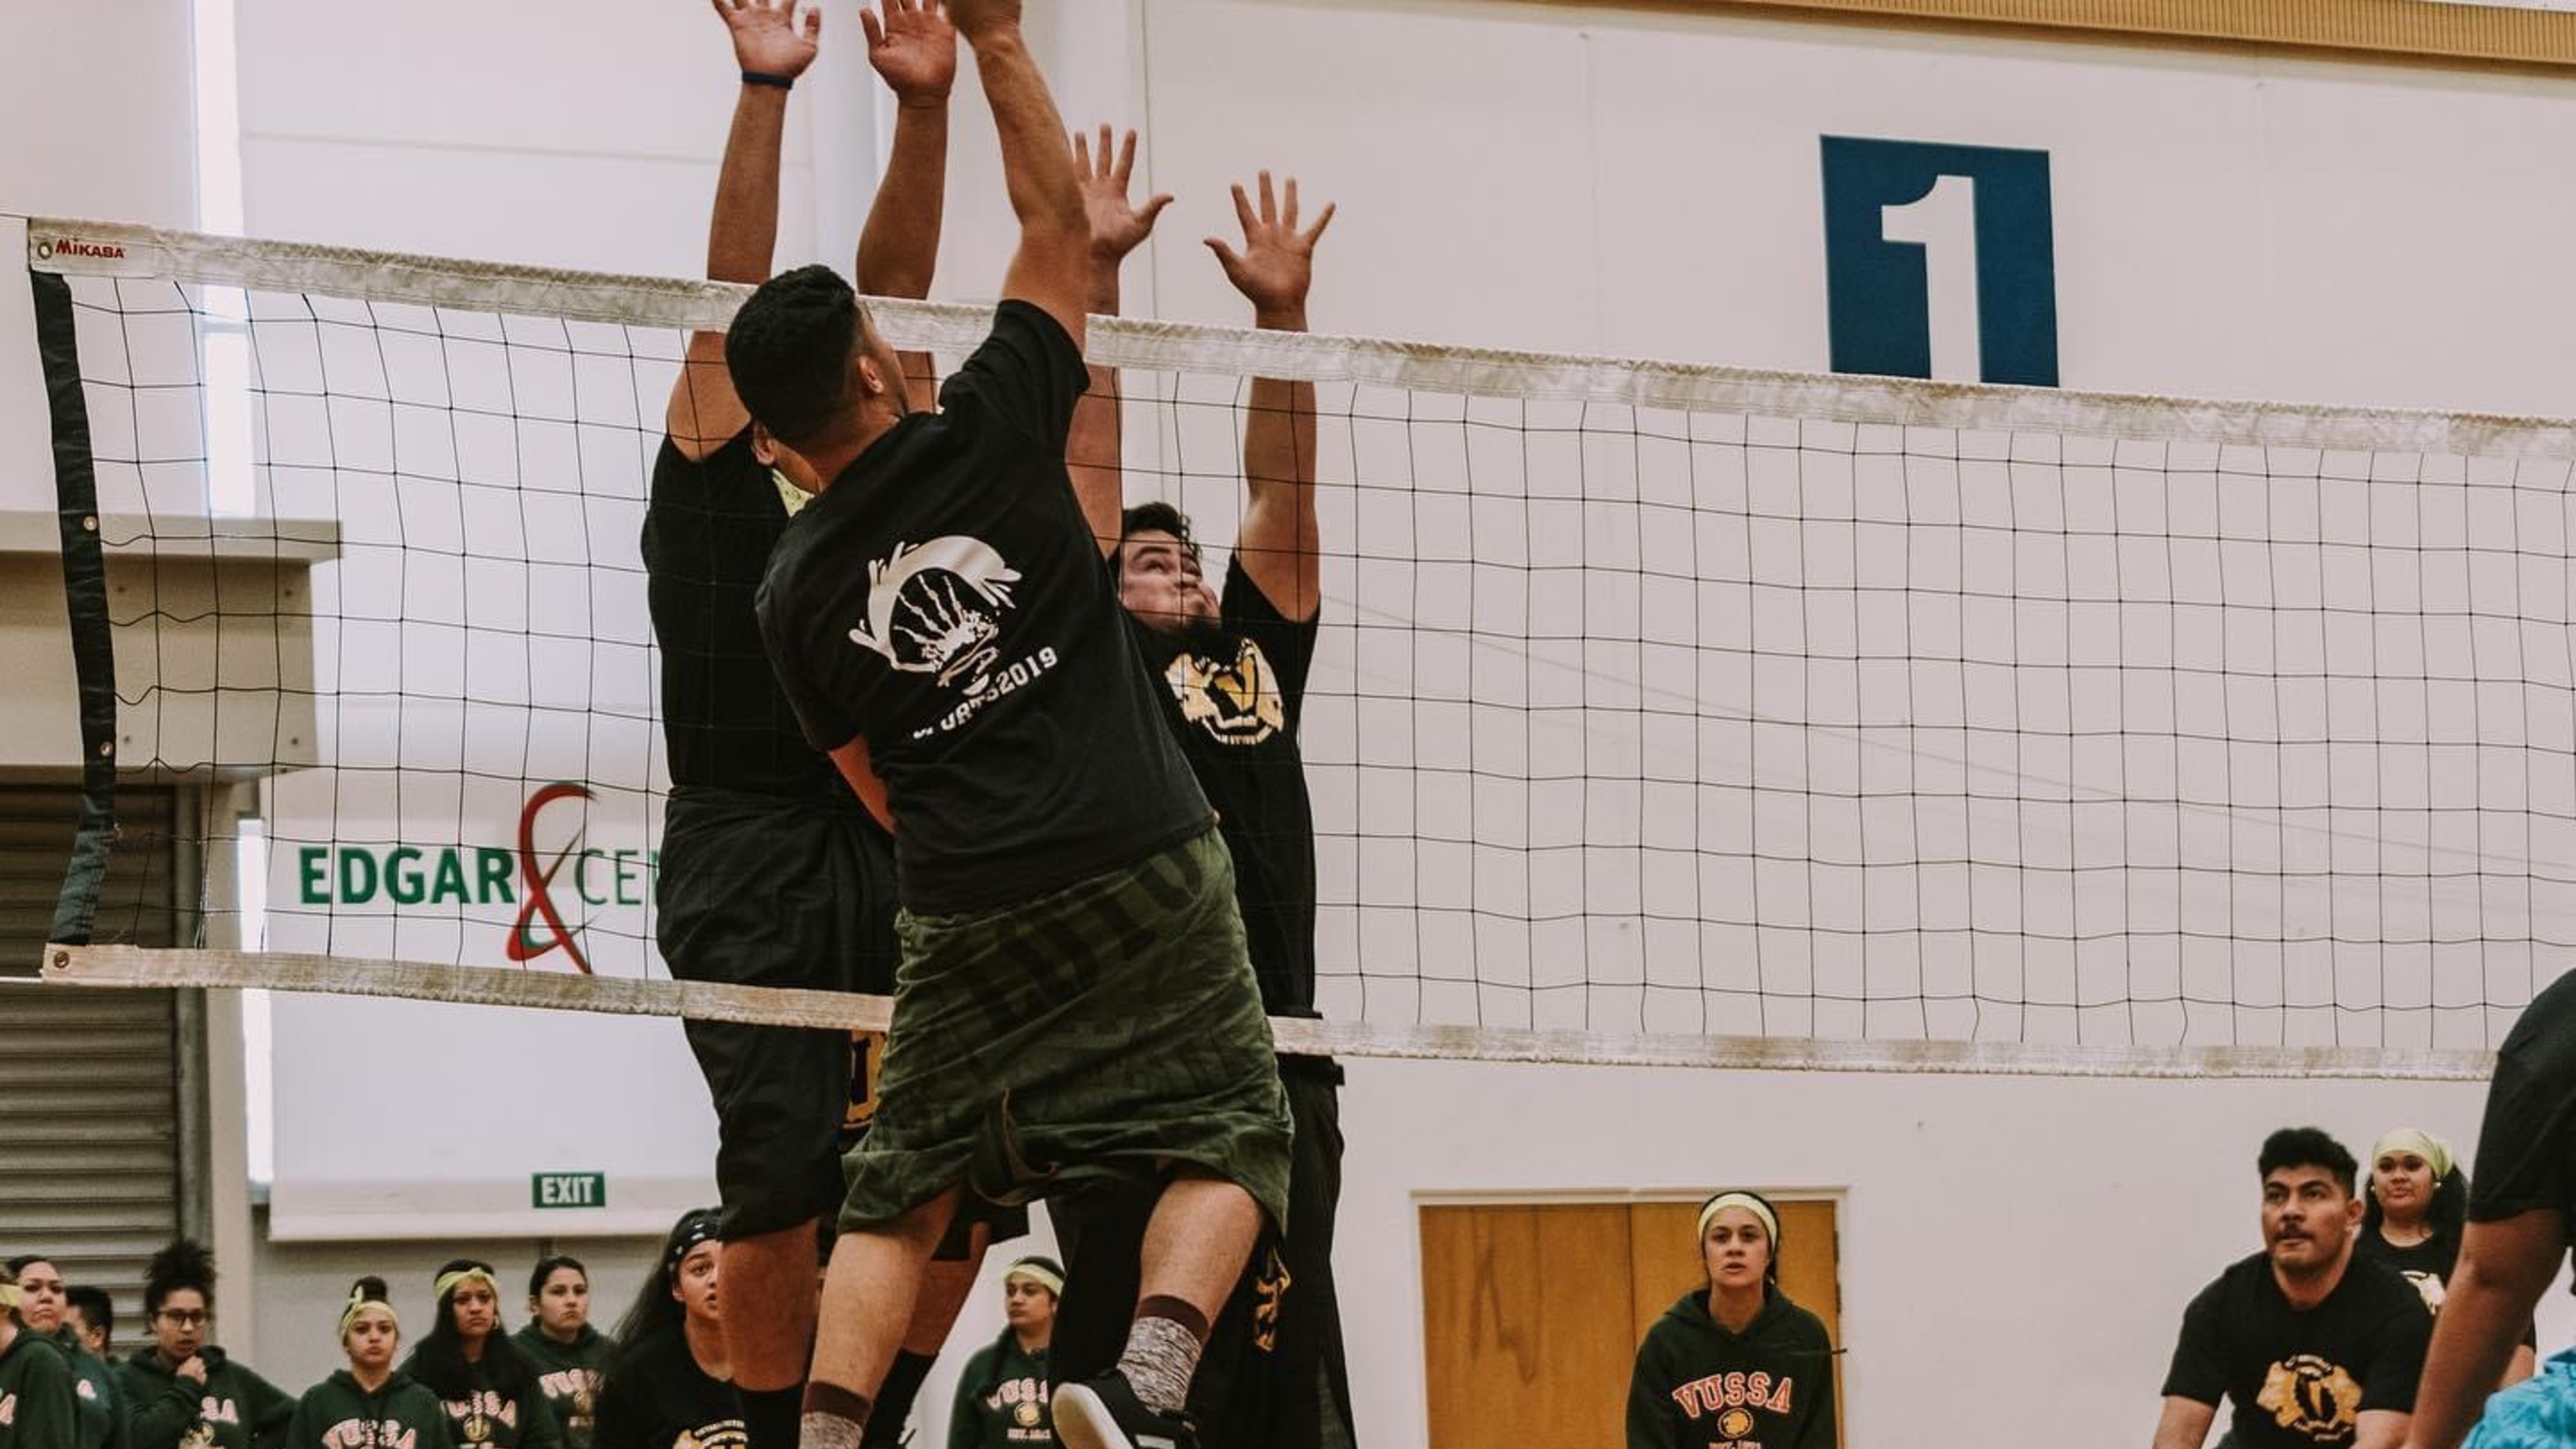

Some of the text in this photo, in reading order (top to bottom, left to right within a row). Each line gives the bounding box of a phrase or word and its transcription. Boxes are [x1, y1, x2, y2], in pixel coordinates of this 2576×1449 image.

[1881, 172, 1981, 381] 1
[299, 847, 659, 906] EDGAR CE
[542, 1176, 595, 1203] EXIT
[1672, 1371, 1793, 1418] VUSSA
